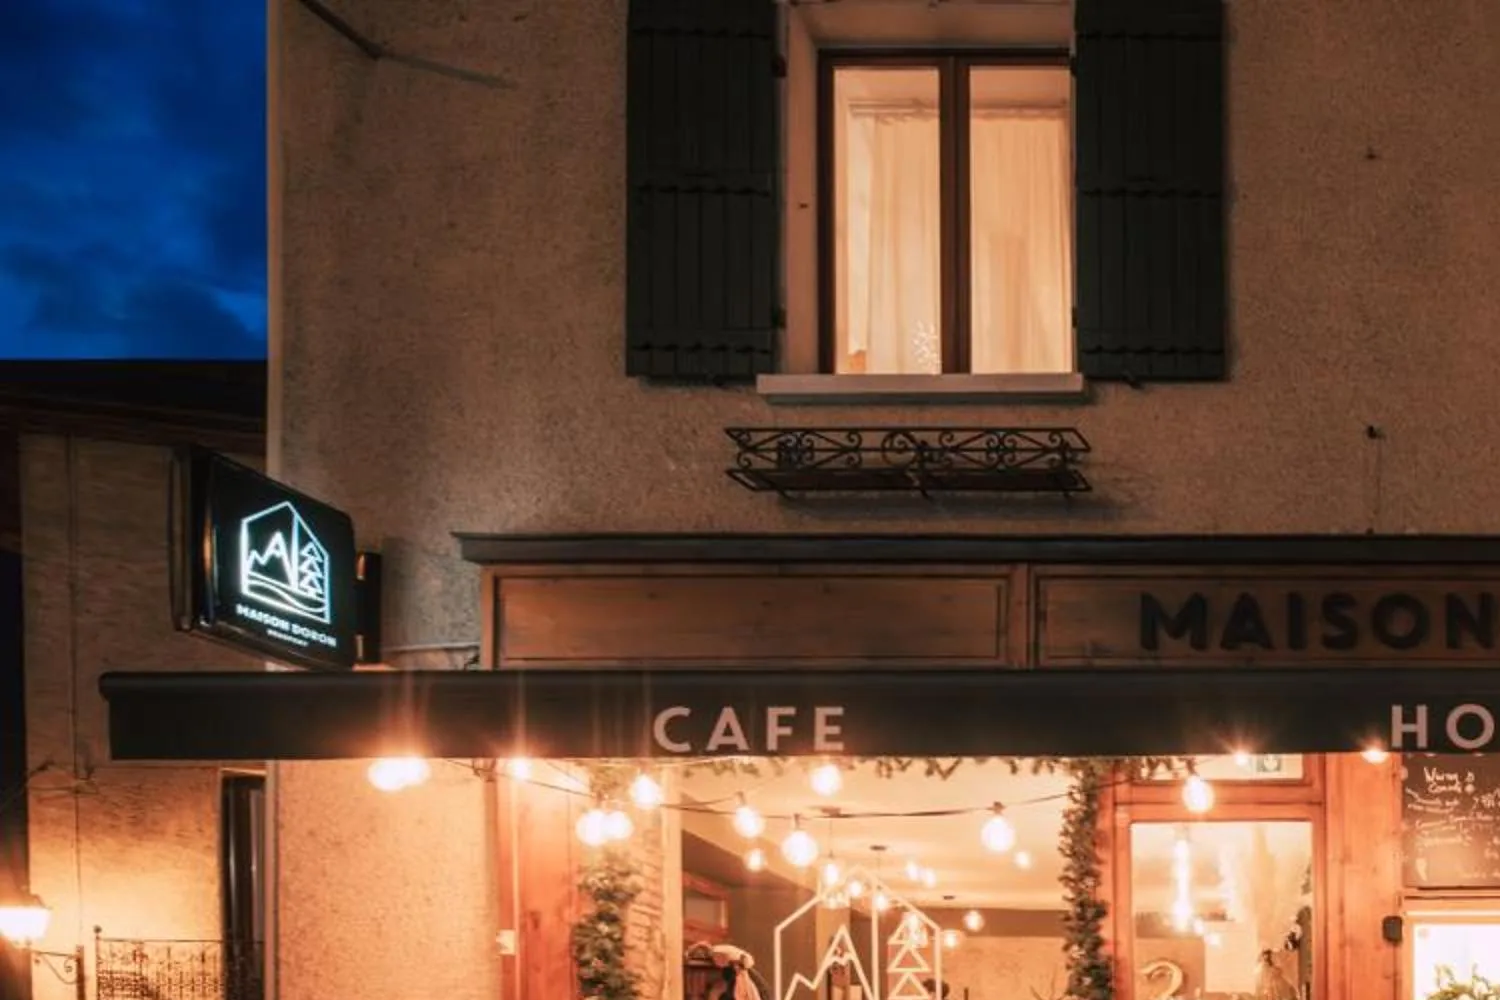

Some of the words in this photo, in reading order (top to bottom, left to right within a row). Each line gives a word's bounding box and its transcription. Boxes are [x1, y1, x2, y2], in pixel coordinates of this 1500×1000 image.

[236, 604, 291, 631] MAISON
[292, 623, 337, 647] DORON
[1140, 592, 1497, 652] MAISON
[653, 705, 845, 753] CAFE
